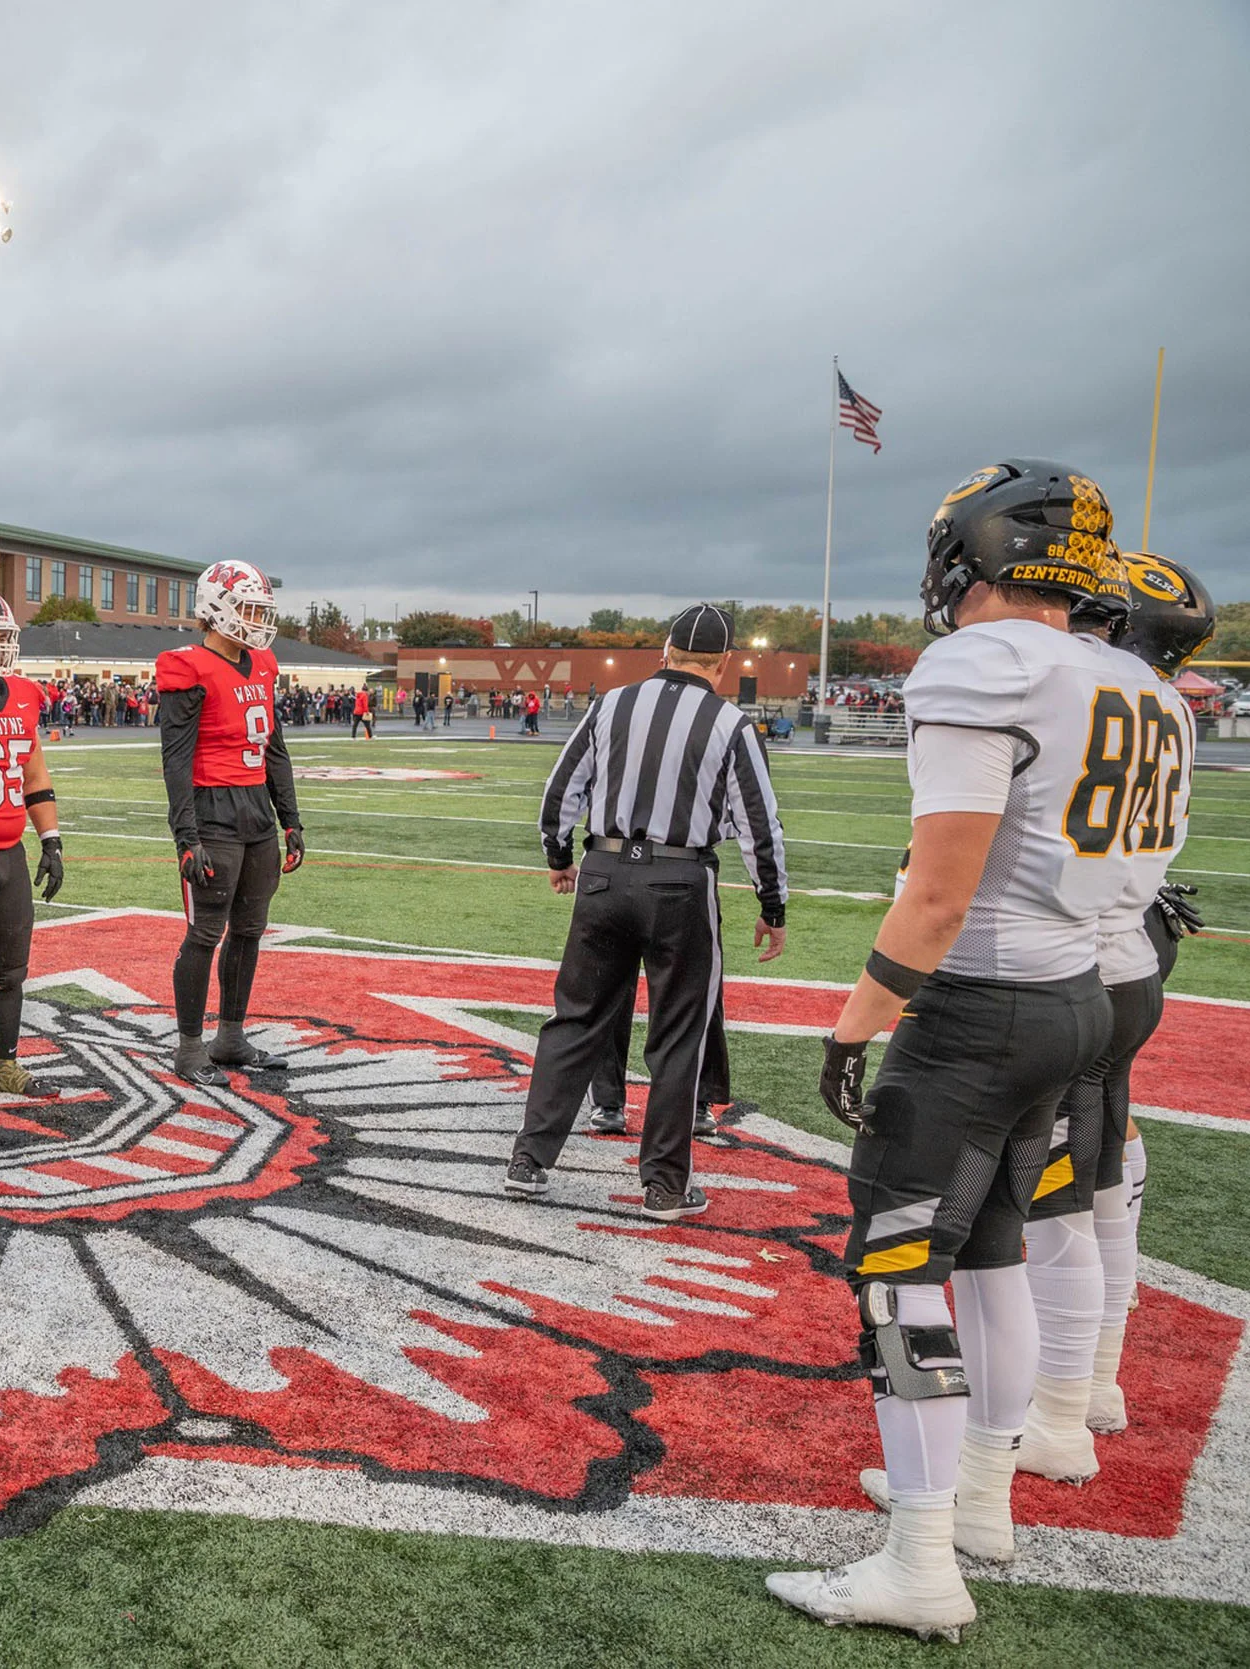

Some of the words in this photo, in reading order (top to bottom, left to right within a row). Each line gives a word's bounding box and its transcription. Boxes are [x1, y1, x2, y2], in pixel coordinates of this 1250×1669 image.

[1047, 544, 1065, 557] 88
[234, 683, 268, 704] WAYNE
[242, 705, 270, 768] 9
[631, 845, 642, 859] S
